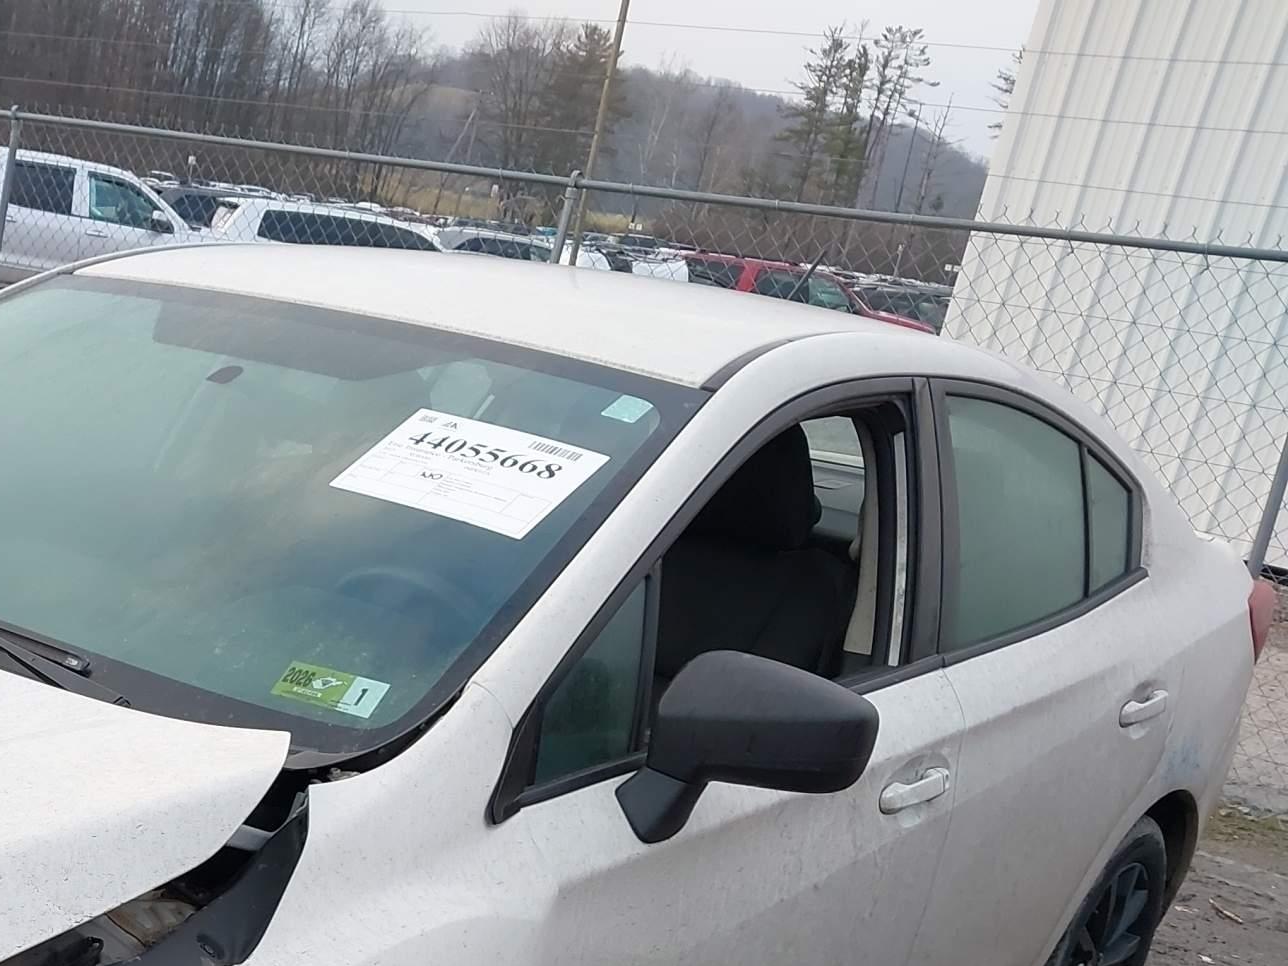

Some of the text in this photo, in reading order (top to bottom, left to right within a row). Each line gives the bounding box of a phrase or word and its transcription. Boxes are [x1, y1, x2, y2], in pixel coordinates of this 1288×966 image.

[409, 431, 563, 480] 44055668
[281, 667, 316, 687] 2026
[353, 687, 369, 706] 1
